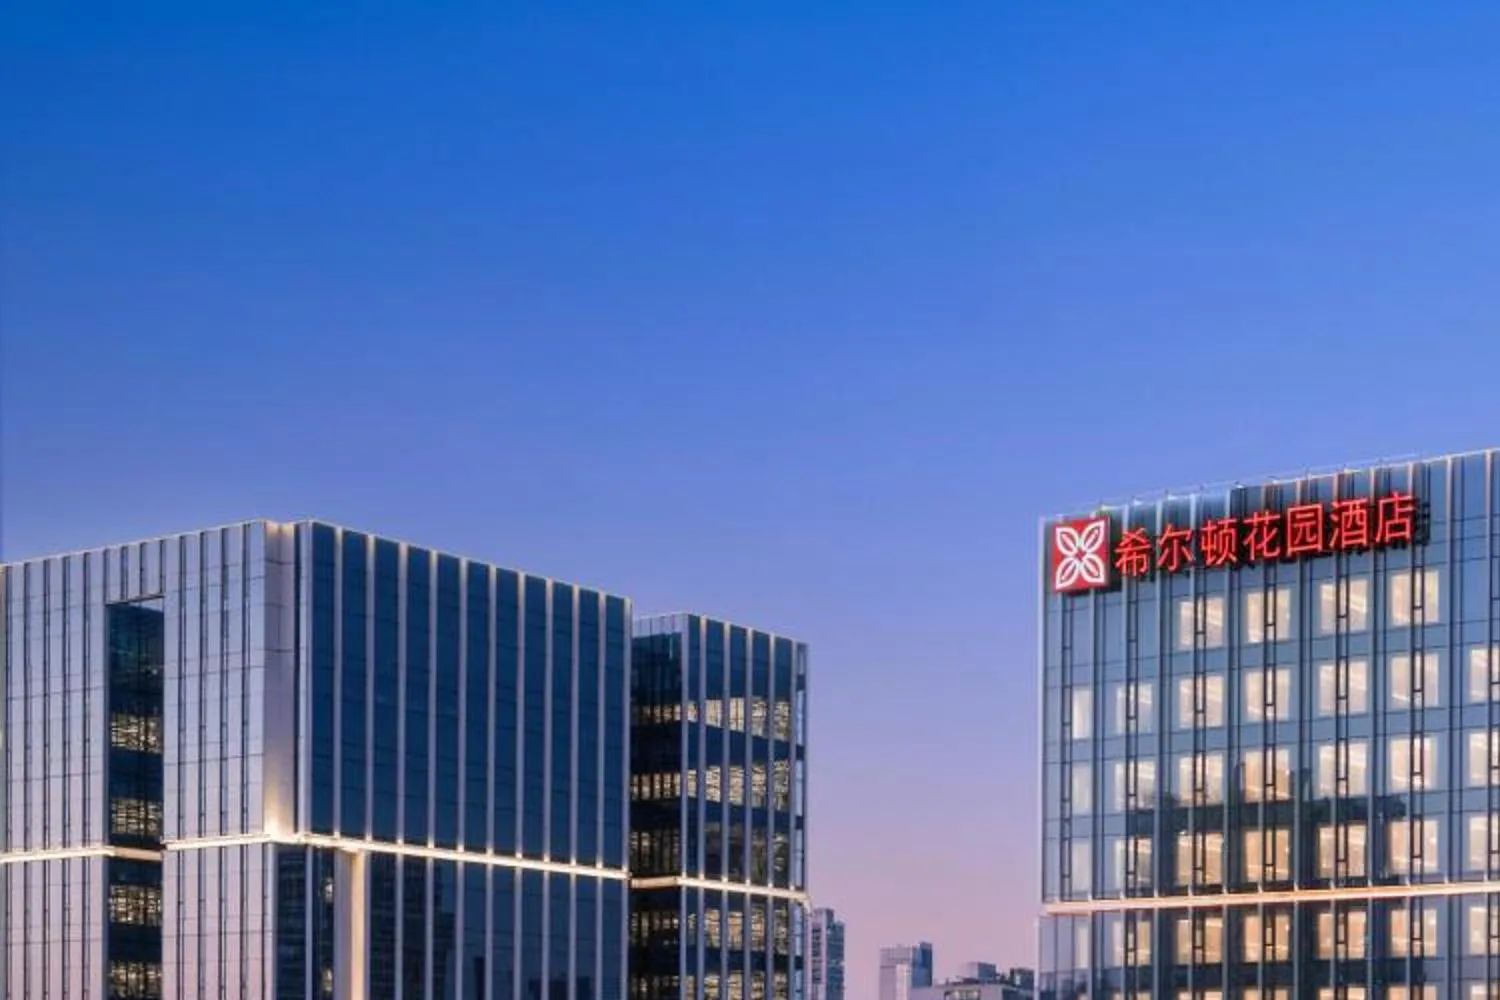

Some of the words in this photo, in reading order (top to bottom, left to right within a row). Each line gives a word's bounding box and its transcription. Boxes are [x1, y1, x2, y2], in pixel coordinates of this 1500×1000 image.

[1114, 491, 1415, 577] 希尔顿花园酒店
